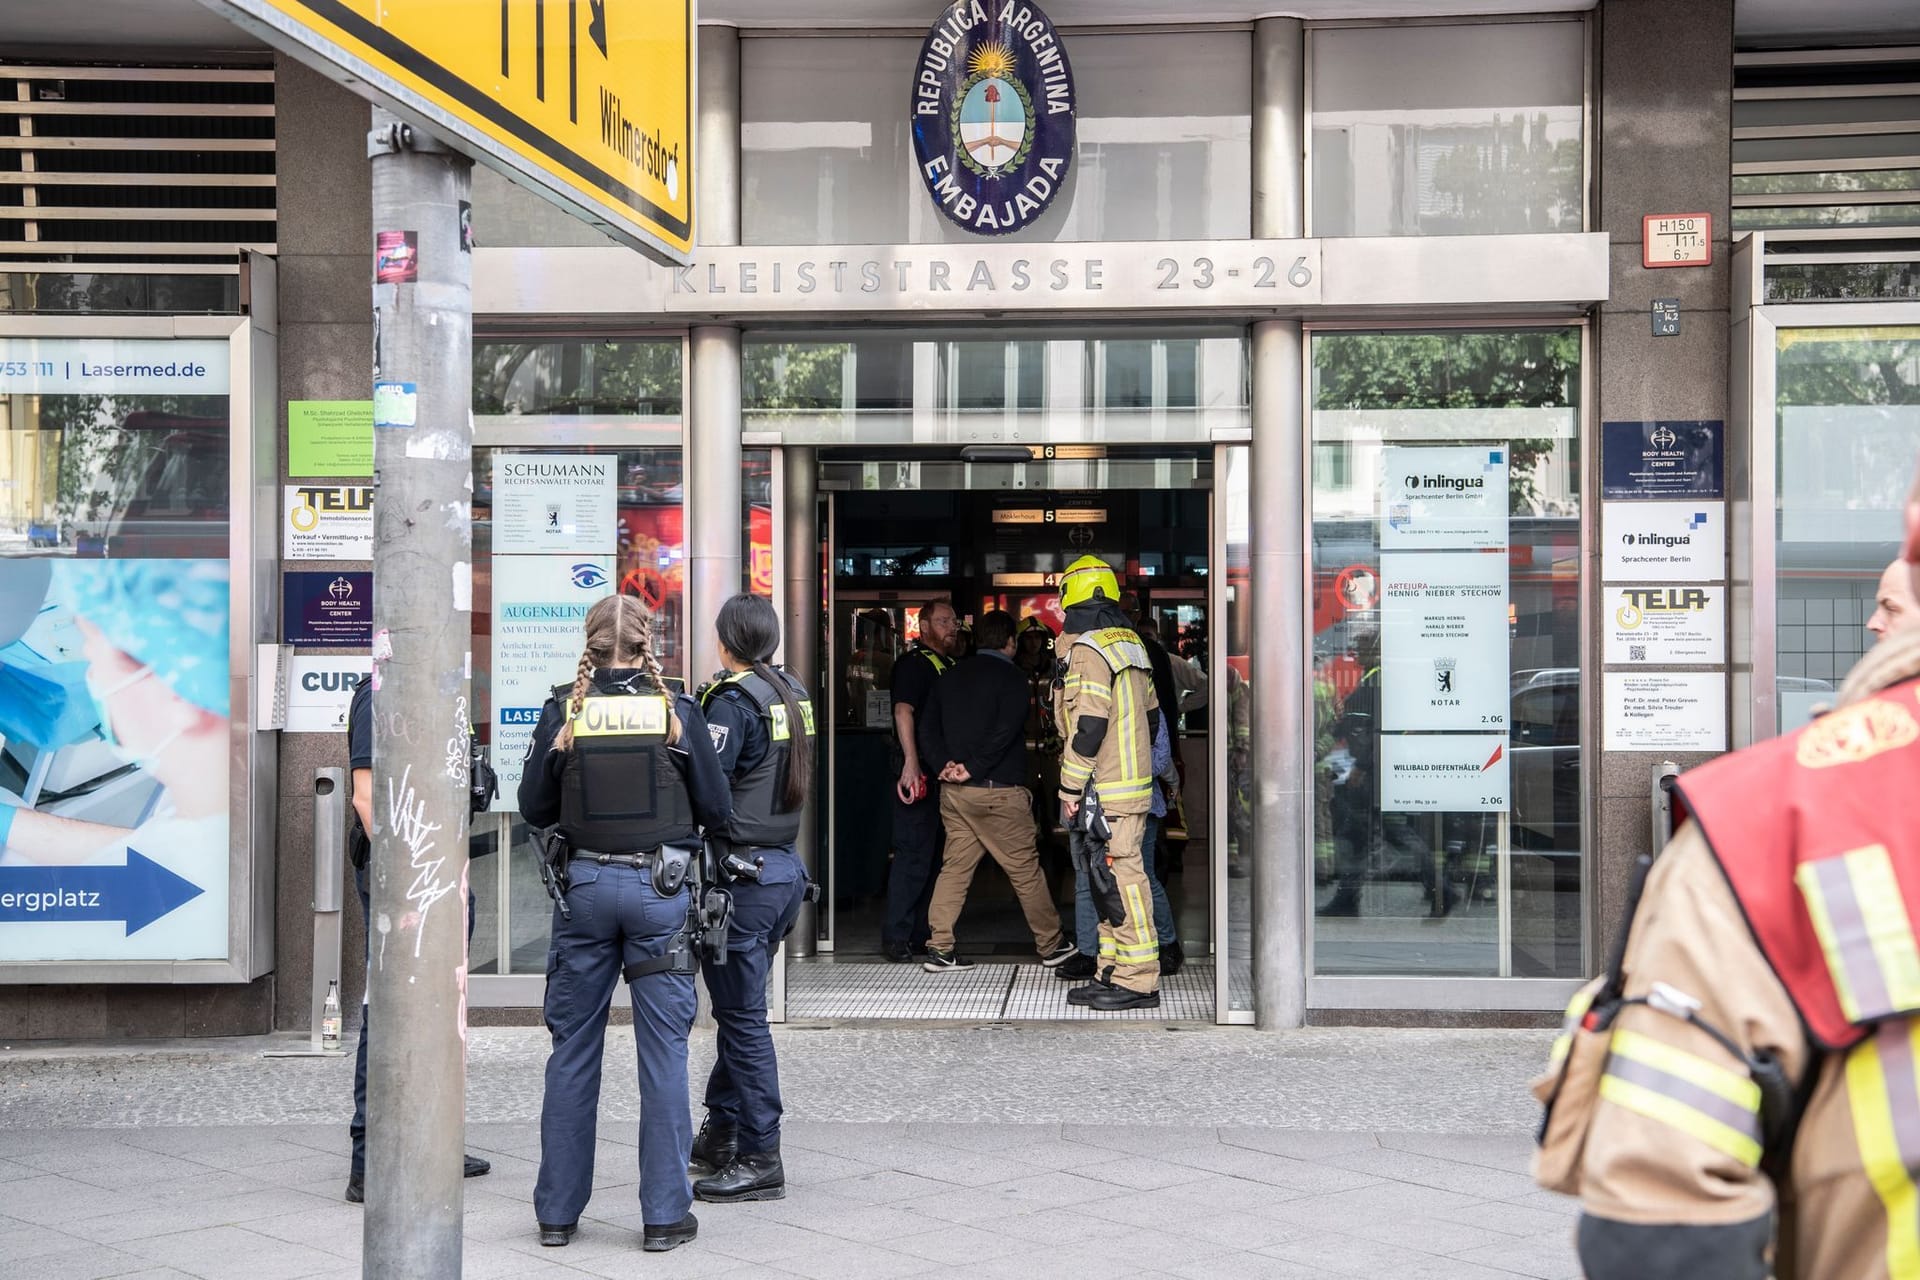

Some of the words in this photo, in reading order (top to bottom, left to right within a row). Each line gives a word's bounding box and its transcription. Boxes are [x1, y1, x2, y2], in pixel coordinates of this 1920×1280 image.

[998, 0, 1070, 115] ARGENTINA
[600, 85, 678, 187] Wilmersdo
[925, 155, 1064, 230] EMBAJADA
[1660, 219, 1694, 232] H150
[672, 259, 1102, 294] KLEISTSTRASSE
[82, 361, 206, 377] Lasermed.de
[1045, 446, 1054, 458] 6
[504, 464, 605, 477] SCHUMANN
[1423, 474, 1483, 491] inlingua
[1045, 510, 1054, 522] 5
[1638, 532, 1690, 548] inlingua
[1621, 555, 1668, 563] Sprachcenter
[1045, 574, 1055, 585] 4
[1388, 582, 1429, 590] ARTEJURA
[1461, 589, 1501, 597] STECHOW
[1622, 589, 1711, 610] TELA
[516, 625, 584, 634] WITTENBERGPL
[1047, 638, 1054, 650] 3
[302, 672, 372, 692] CUR
[574, 700, 663, 731] OLIZEI
[1481, 715, 1489, 723] 2.
[1491, 715, 1503, 723] OG
[1431, 763, 1480, 771] DIEFENTHÄLER
[1481, 797, 1489, 805] 2.
[1491, 797, 1503, 805] OG
[1, 888, 100, 911] ergplatz
